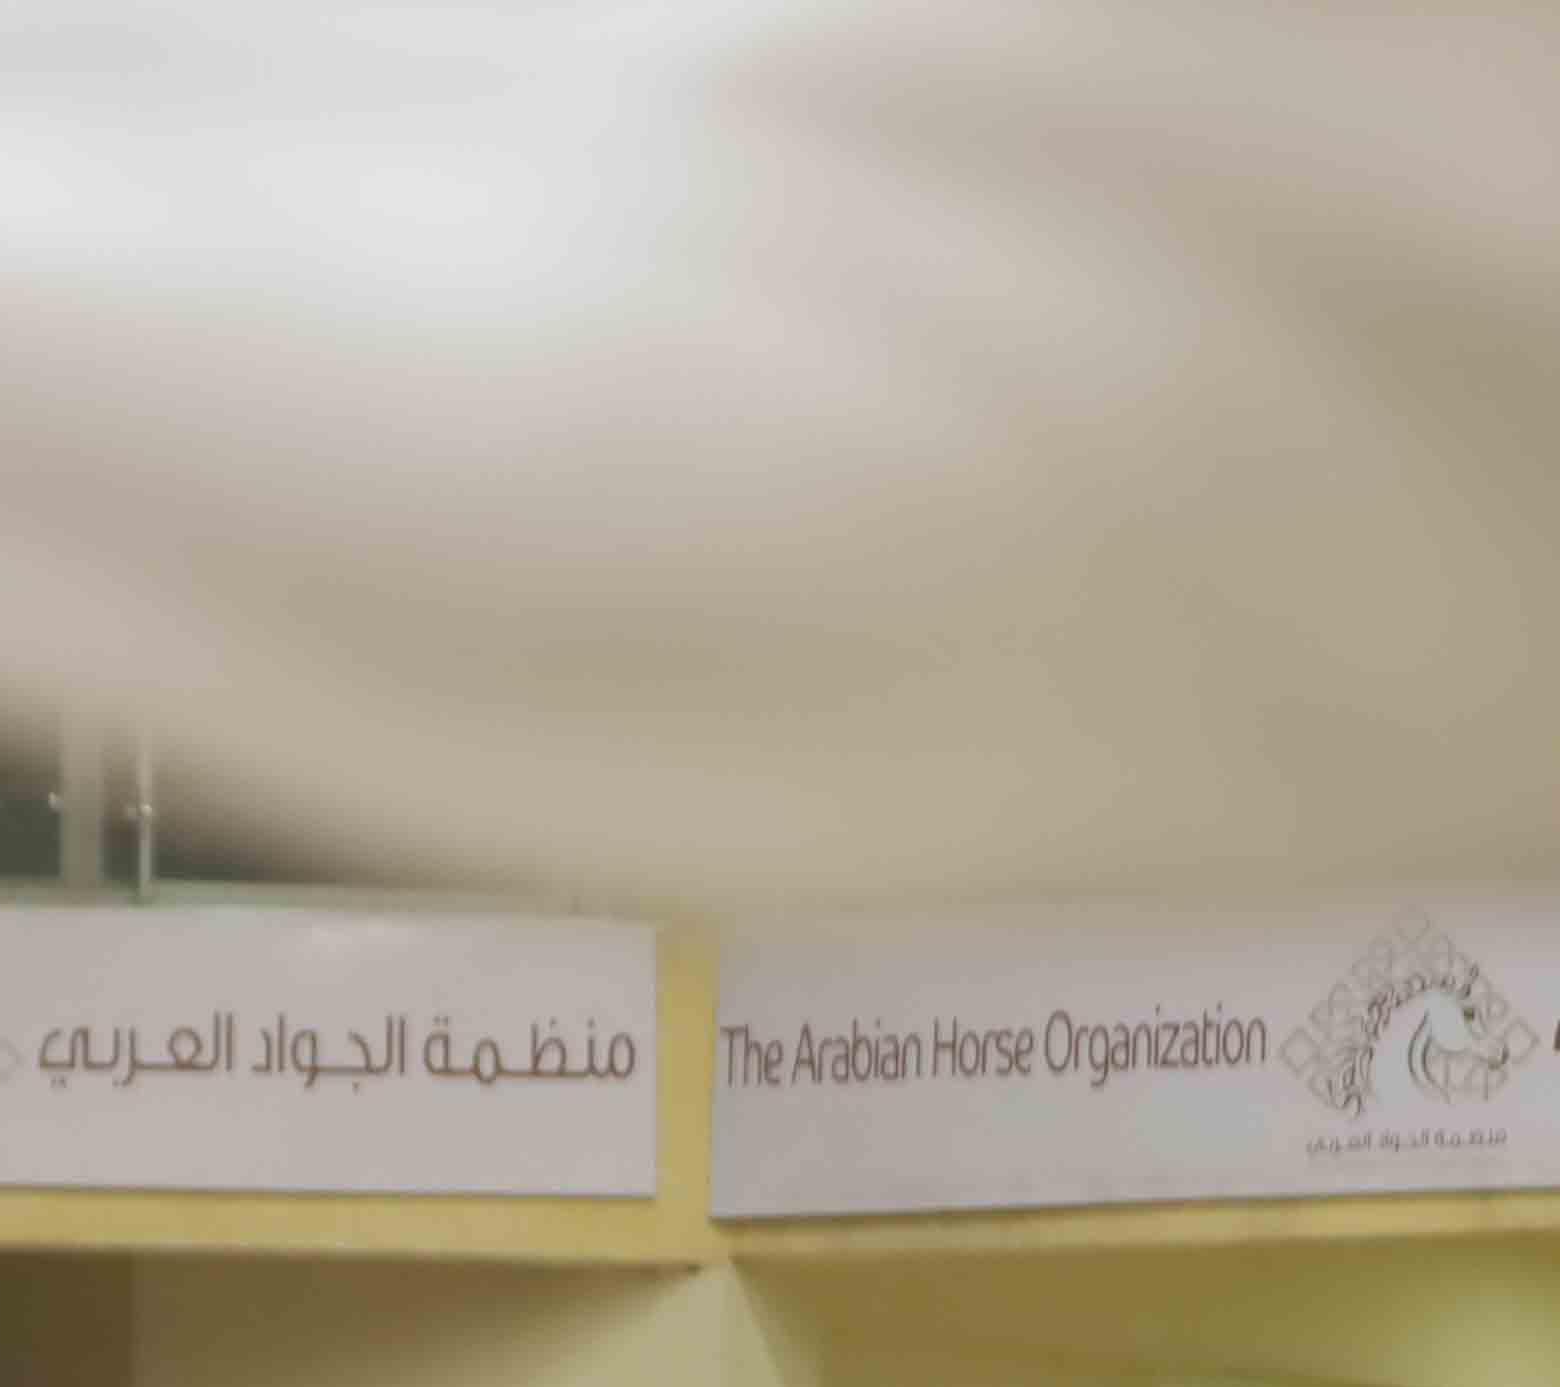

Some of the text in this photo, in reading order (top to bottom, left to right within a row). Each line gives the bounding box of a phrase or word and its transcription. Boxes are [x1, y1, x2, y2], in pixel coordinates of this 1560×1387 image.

[38, 1012, 636, 1095] منظمة الجواد العربي
[720, 1001, 1269, 1089] The Arabian Horse Organization
